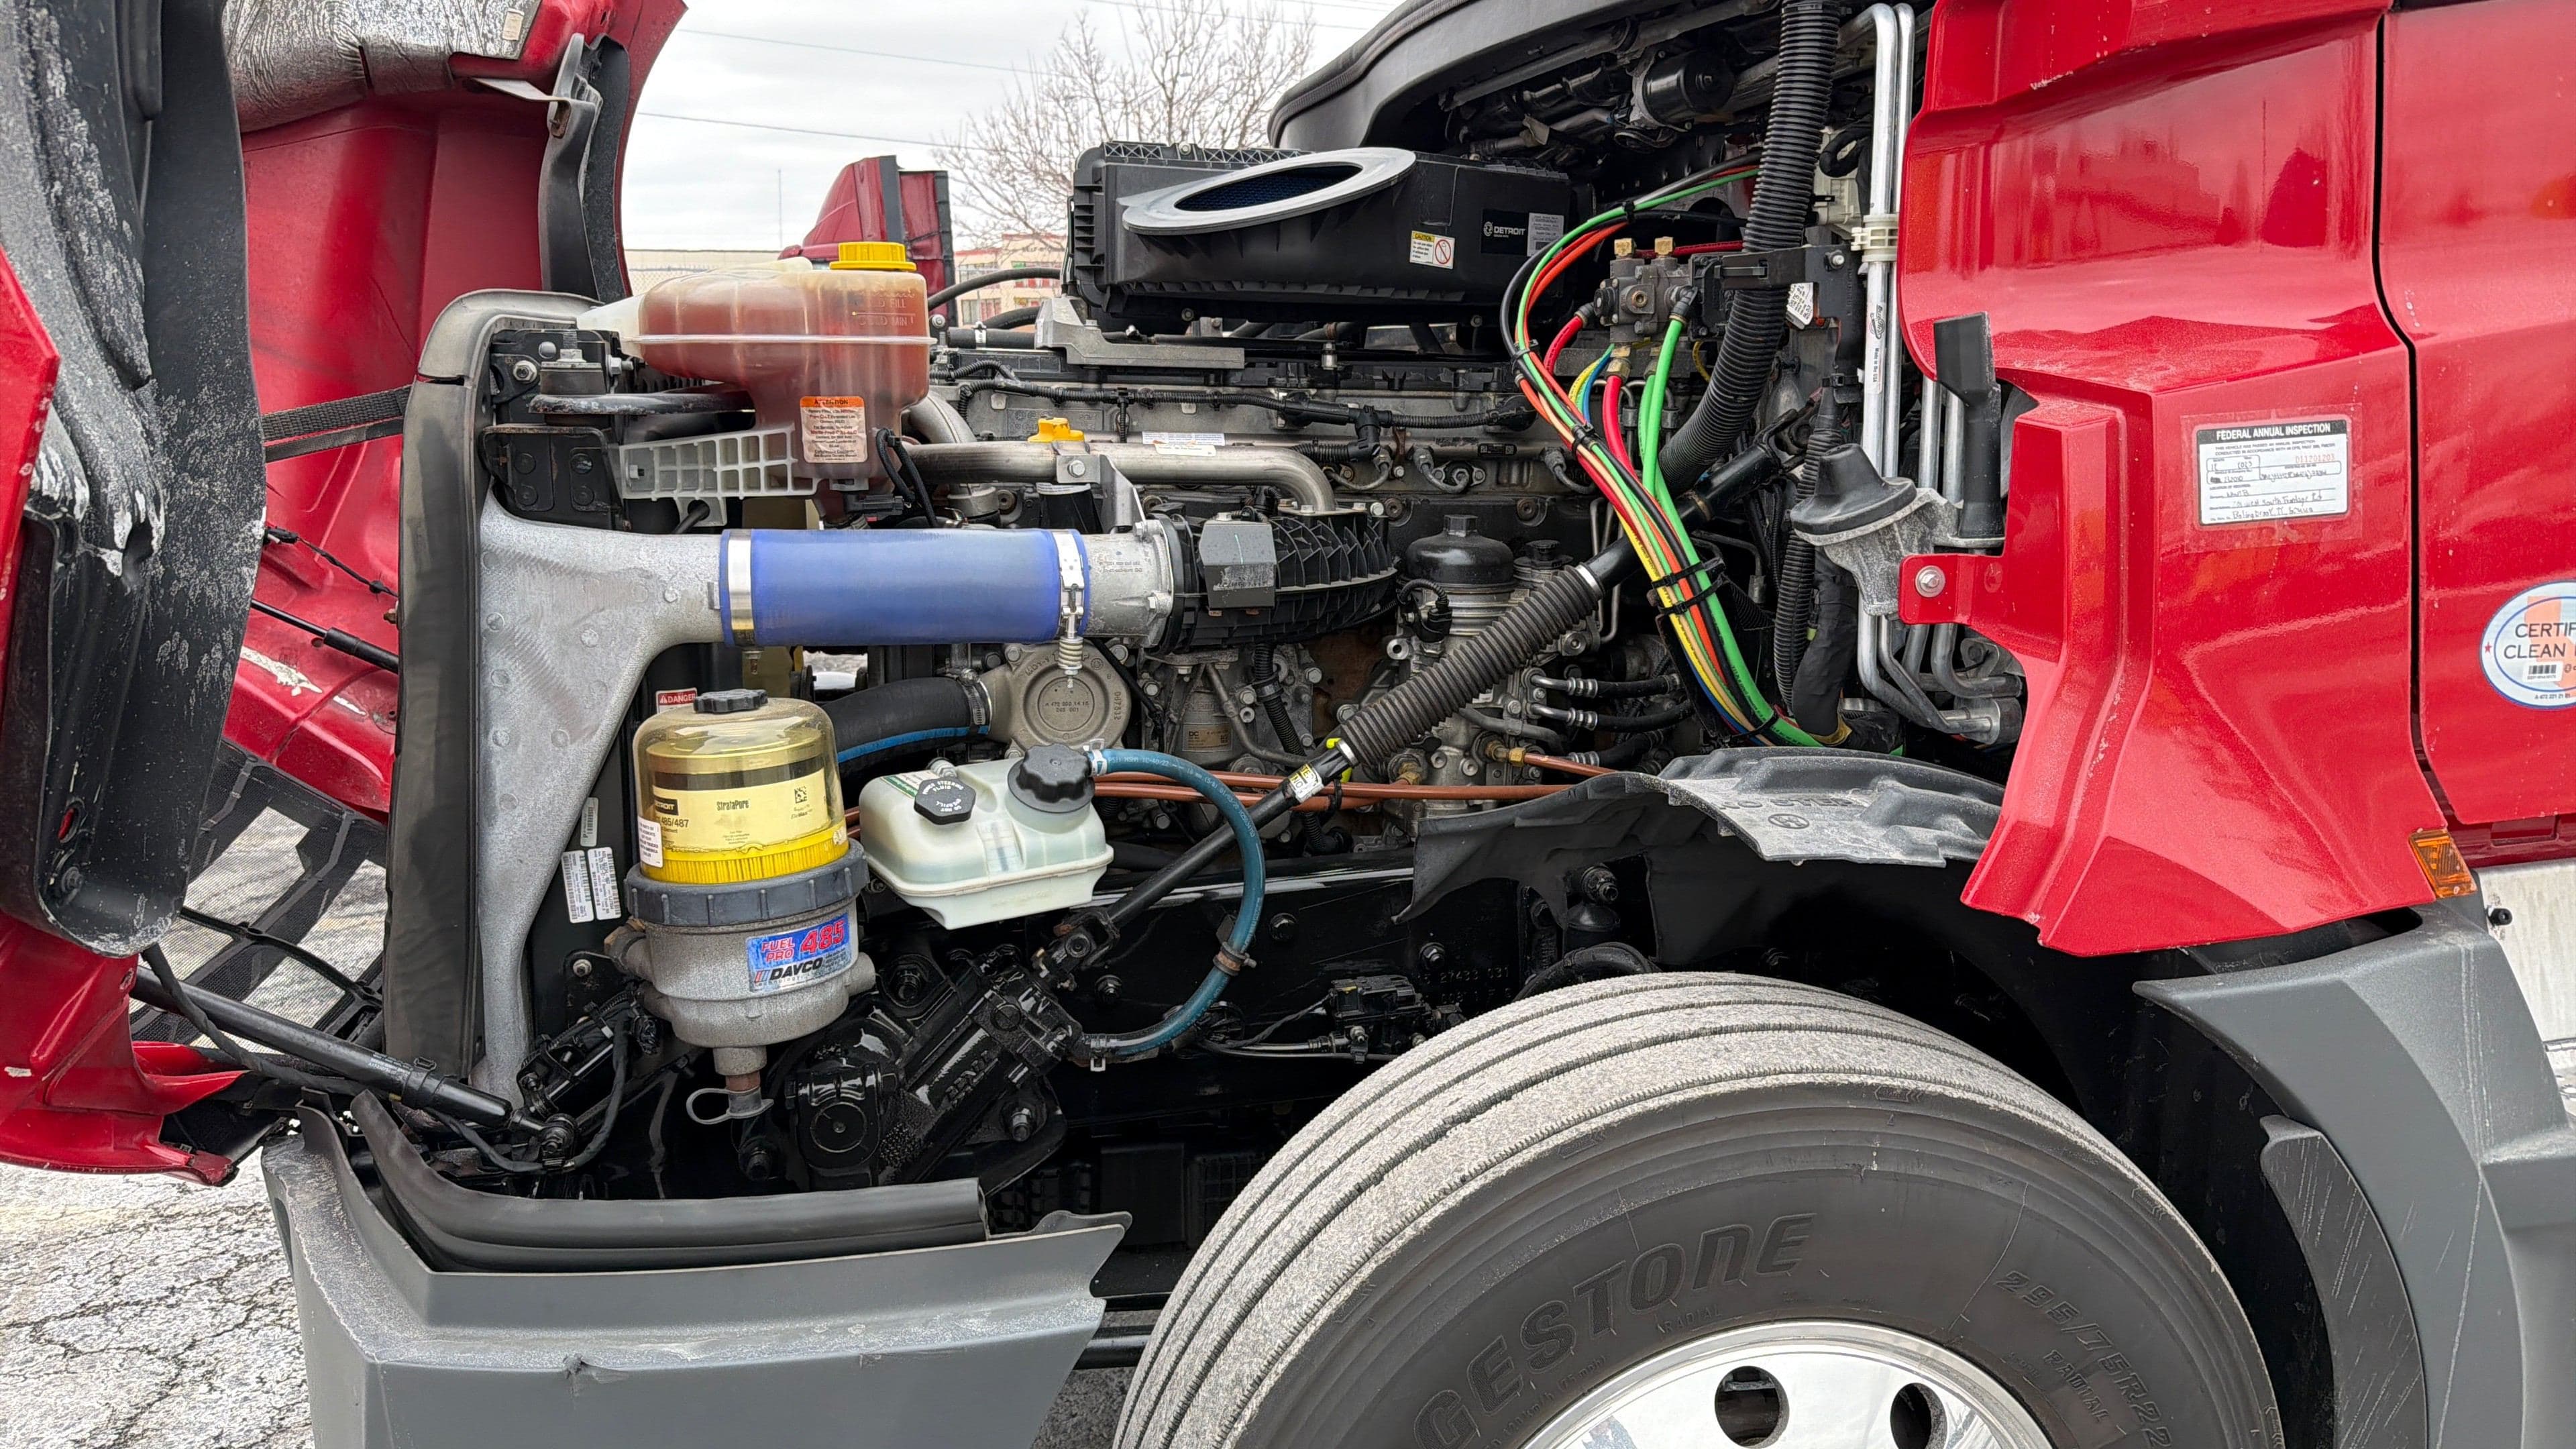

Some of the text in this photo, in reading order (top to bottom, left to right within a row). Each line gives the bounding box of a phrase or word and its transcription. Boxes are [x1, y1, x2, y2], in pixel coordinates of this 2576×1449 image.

[1493, 226, 1526, 235] DETROIT
[2216, 423, 2331, 440] FEDERAL ANNUAL INSPECTION
[2504, 643, 2566, 659] CLEAN
[937, 780, 964, 790] STEERING
[716, 798, 749, 811] StrataPore
[762, 920, 846, 954] FUEL 485
[766, 948, 794, 963] PRO
[769, 957, 824, 981] DAVCO
[1664, 1303, 1723, 1334] RADIAL
[2043, 1349, 2110, 1423] RADIAL
